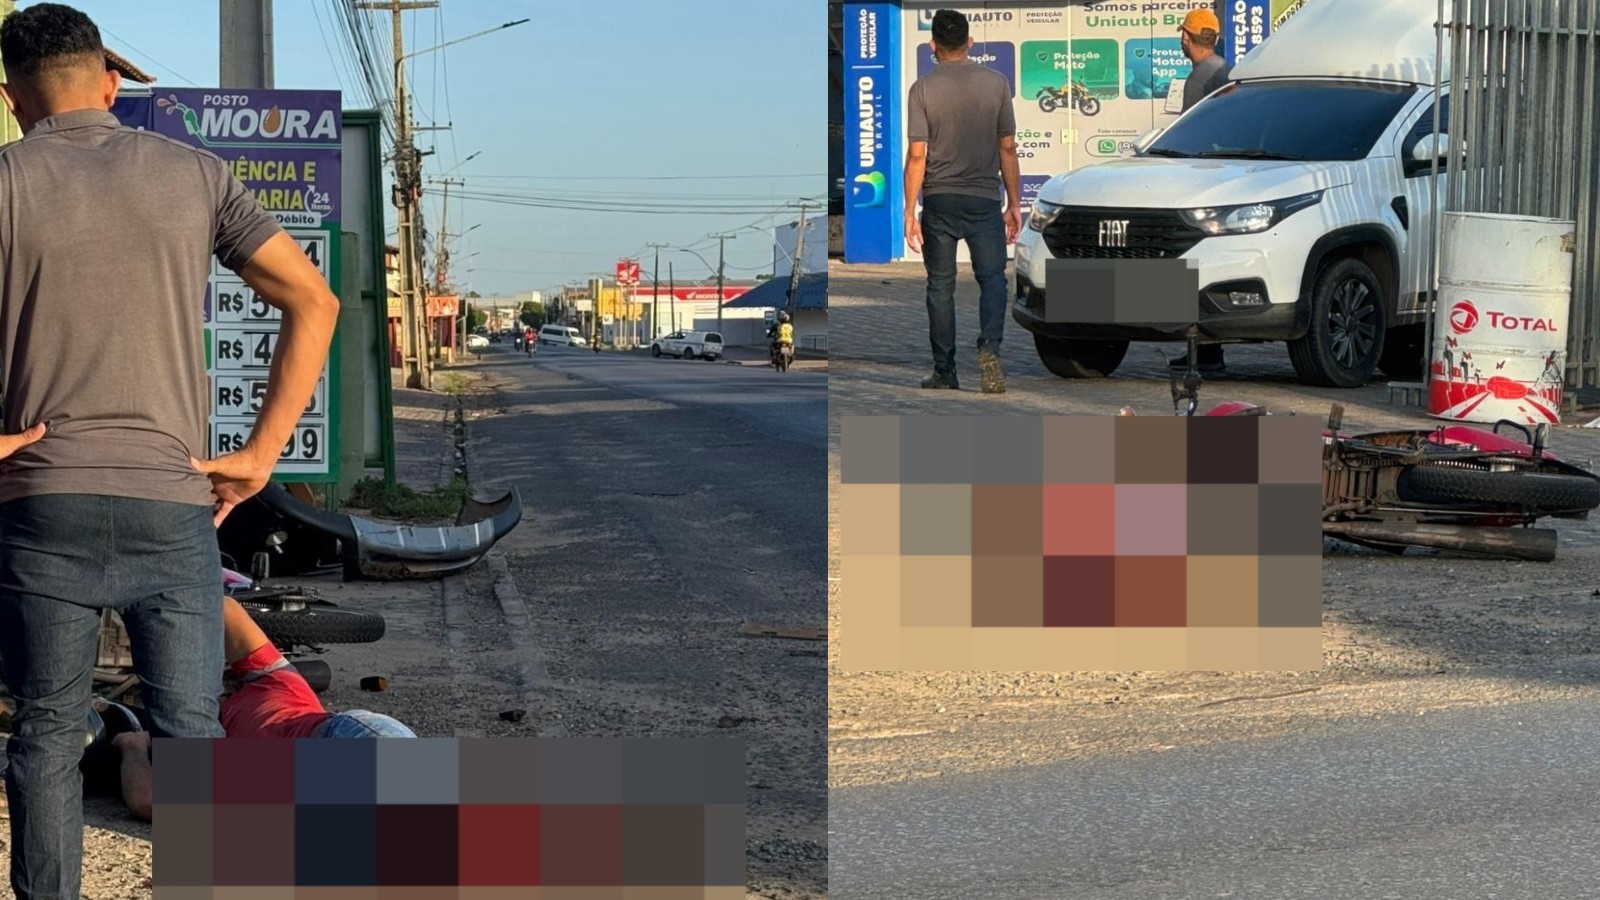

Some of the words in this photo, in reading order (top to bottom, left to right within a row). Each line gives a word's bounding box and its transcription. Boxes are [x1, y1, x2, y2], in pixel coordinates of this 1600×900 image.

[1084, 2, 1137, 12] Somos
[1142, 0, 1217, 13] parceiros
[964, 12, 1012, 22] IAUTO
[1086, 16, 1159, 27] Uniauto
[1251, 5, 1263, 45] 8593
[859, 9, 868, 58] PROTEÇÃO
[869, 12, 877, 58] VEICULAR
[1152, 67, 1176, 77] App
[203, 94, 249, 106] POSTO
[201, 107, 338, 138] MOURA
[859, 76, 874, 167] UNIAUTO
[1017, 129, 1041, 140] ção
[303, 161, 316, 182] E
[313, 193, 330, 204] 24
[1099, 219, 1129, 247] FIAT
[1486, 311, 1557, 331] TOTAL
